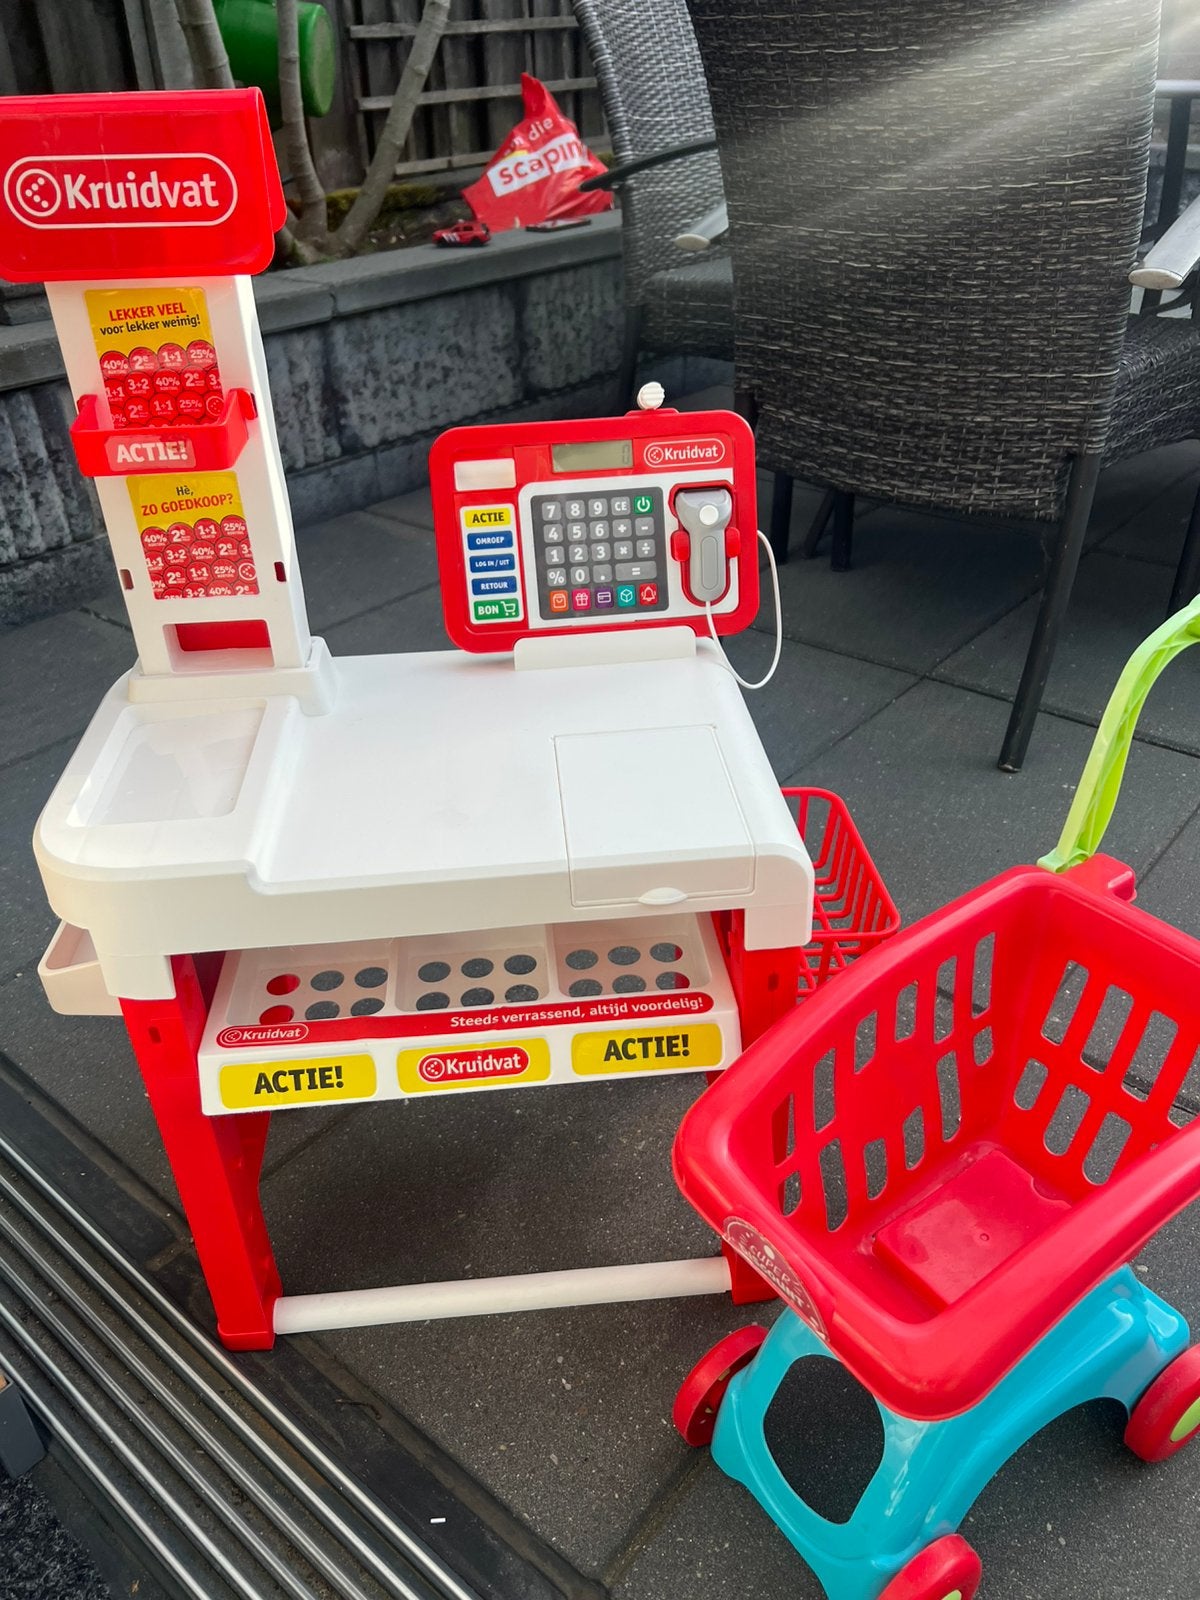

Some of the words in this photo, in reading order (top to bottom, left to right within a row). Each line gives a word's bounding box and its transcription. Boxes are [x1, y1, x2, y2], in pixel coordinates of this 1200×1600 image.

[528, 117, 554, 141] die
[499, 140, 587, 187] scapin
[63, 170, 219, 209] Kruidvat
[109, 305, 155, 321] LEKKER
[157, 302, 187, 316] VEEL
[100, 325, 123, 335] voor
[126, 320, 160, 332] lekker
[162, 314, 201, 328] weinig!
[103, 360, 129, 370] 40%
[162, 351, 183, 362] 1+1
[190, 349, 214, 359] 25%
[128, 378, 150, 390] 3+2
[153, 400, 173, 411] 1+1
[179, 399, 202, 409] 25%
[117, 440, 188, 463] ACTIE!
[664, 445, 718, 461] Kruidvat
[141, 504, 158, 516] ZO
[161, 493, 234, 513] GOEDKOOP?
[546, 505, 556, 518] 7
[571, 503, 581, 516] 8
[593, 502, 603, 515] 9
[614, 501, 627, 511] CE
[472, 511, 505, 524] ACTIE
[144, 535, 168, 543] 40%
[198, 524, 217, 535] 1+1
[223, 522, 246, 531] 25%
[475, 536, 505, 545] OMROEP
[548, 528, 558, 540] 4
[572, 525, 582, 537] 5
[595, 524, 605, 537] 6
[166, 550, 187, 560] 3+2
[192, 547, 215, 556] 40%
[551, 549, 560, 562] 1
[574, 547, 584, 560] 2
[596, 545, 606, 558] 3
[190, 567, 209, 577] 1+1
[213, 565, 236, 574] 25%
[549, 571, 565, 584] %
[575, 569, 585, 582] 0
[480, 581, 509, 590] RETOUR
[477, 603, 499, 616] BON
[241, 1026, 302, 1041] Kruidvat
[450, 1013, 499, 1028] Steeds
[501, 1007, 586, 1024] verrassend,
[589, 1001, 628, 1019] altijd
[630, 997, 704, 1014] voordelig!
[603, 1034, 691, 1061] ACTIE!
[444, 1052, 524, 1075] Kruidvat
[254, 1066, 345, 1095] ACTIE!
